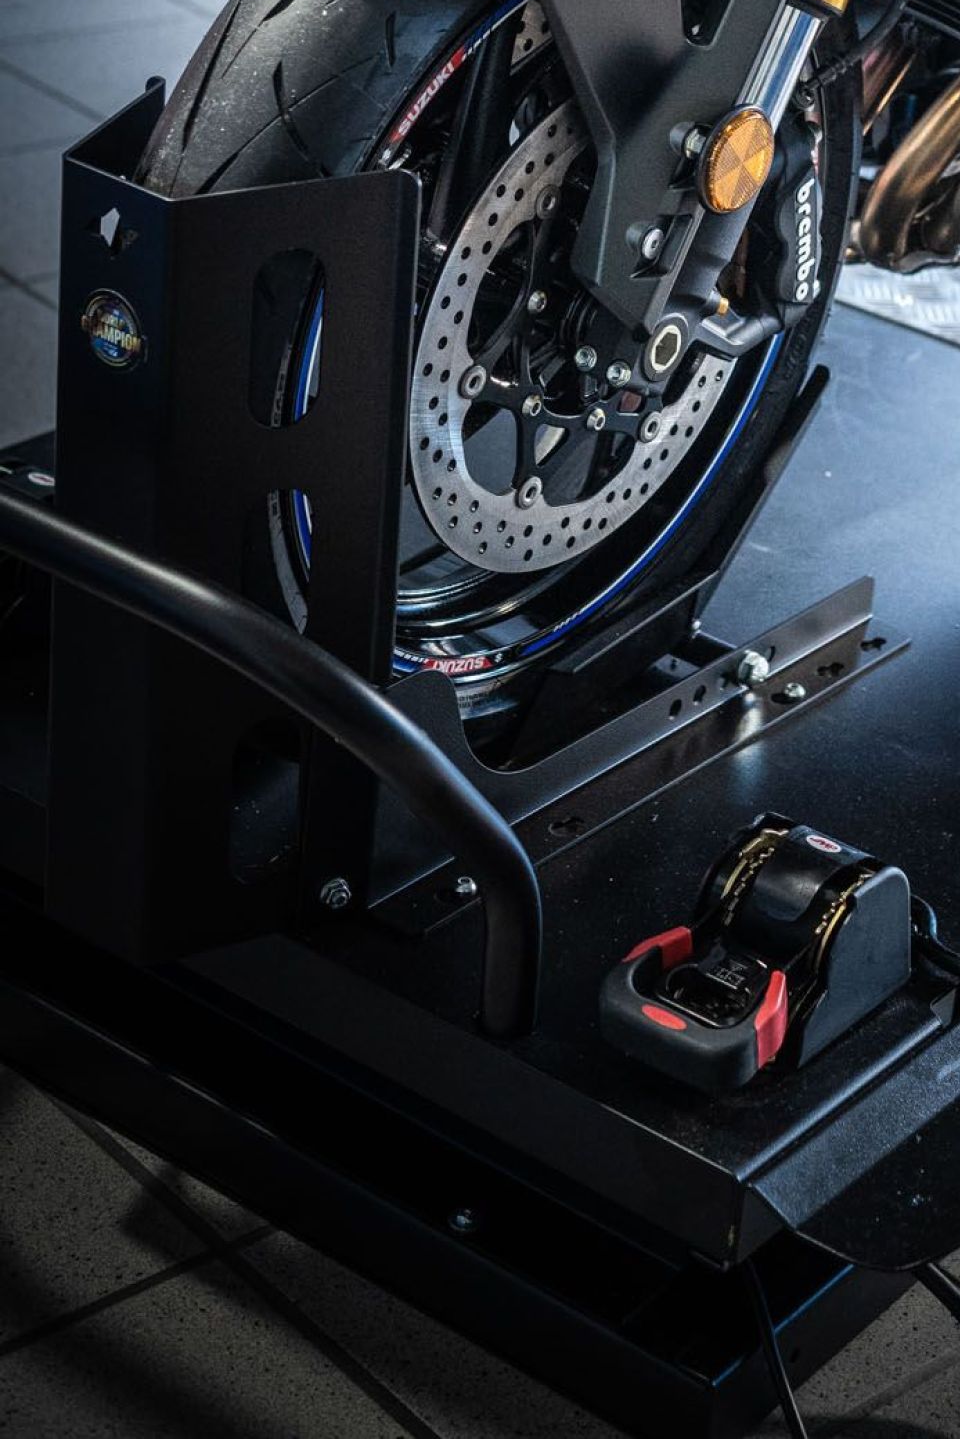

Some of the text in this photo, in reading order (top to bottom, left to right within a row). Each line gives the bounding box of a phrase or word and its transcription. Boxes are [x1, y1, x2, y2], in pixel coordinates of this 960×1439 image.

[398, 61, 455, 135] SUZUKI
[796, 178, 815, 301] brembo
[432, 656, 485, 674] SUZUKI
